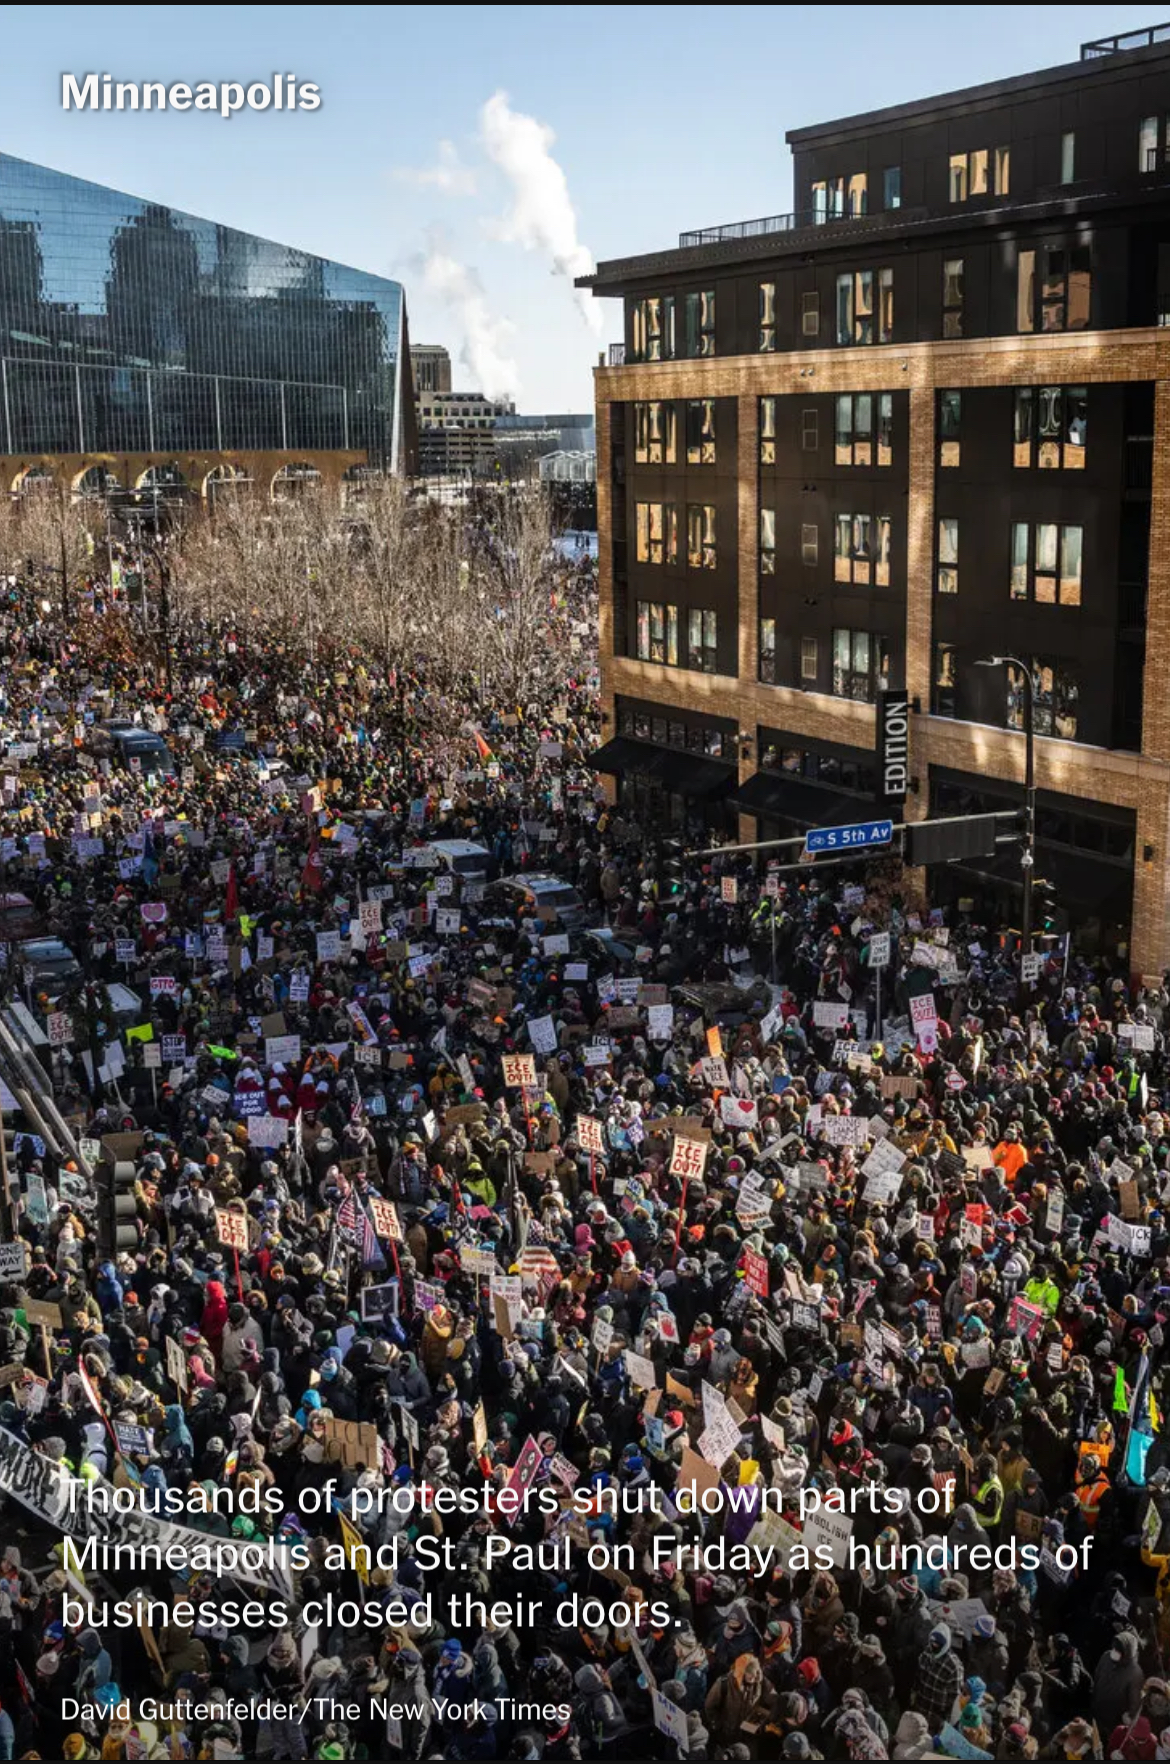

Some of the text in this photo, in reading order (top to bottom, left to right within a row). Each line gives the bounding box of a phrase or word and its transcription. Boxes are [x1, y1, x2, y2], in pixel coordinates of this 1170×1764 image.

[885, 702, 908, 795] EDITION
[828, 824, 889, 845] S 5th Av
[912, 999, 932, 1009] ICE
[837, 1041, 858, 1052] ICE
[357, 1051, 380, 1063] ICE
[506, 1063, 531, 1075] ICE
[508, 1073, 533, 1084] OUT!
[710, 1072, 724, 1082] ICE
[675, 1143, 702, 1161] ICE
[672, 1157, 702, 1176] OUT!
[373, 1205, 394, 1220] ICE
[219, 1214, 243, 1230] ICE
[0, 1256, 22, 1267] WAY
[333, 1421, 375, 1446] ICE
[806, 1513, 847, 1543] ABOLISH
